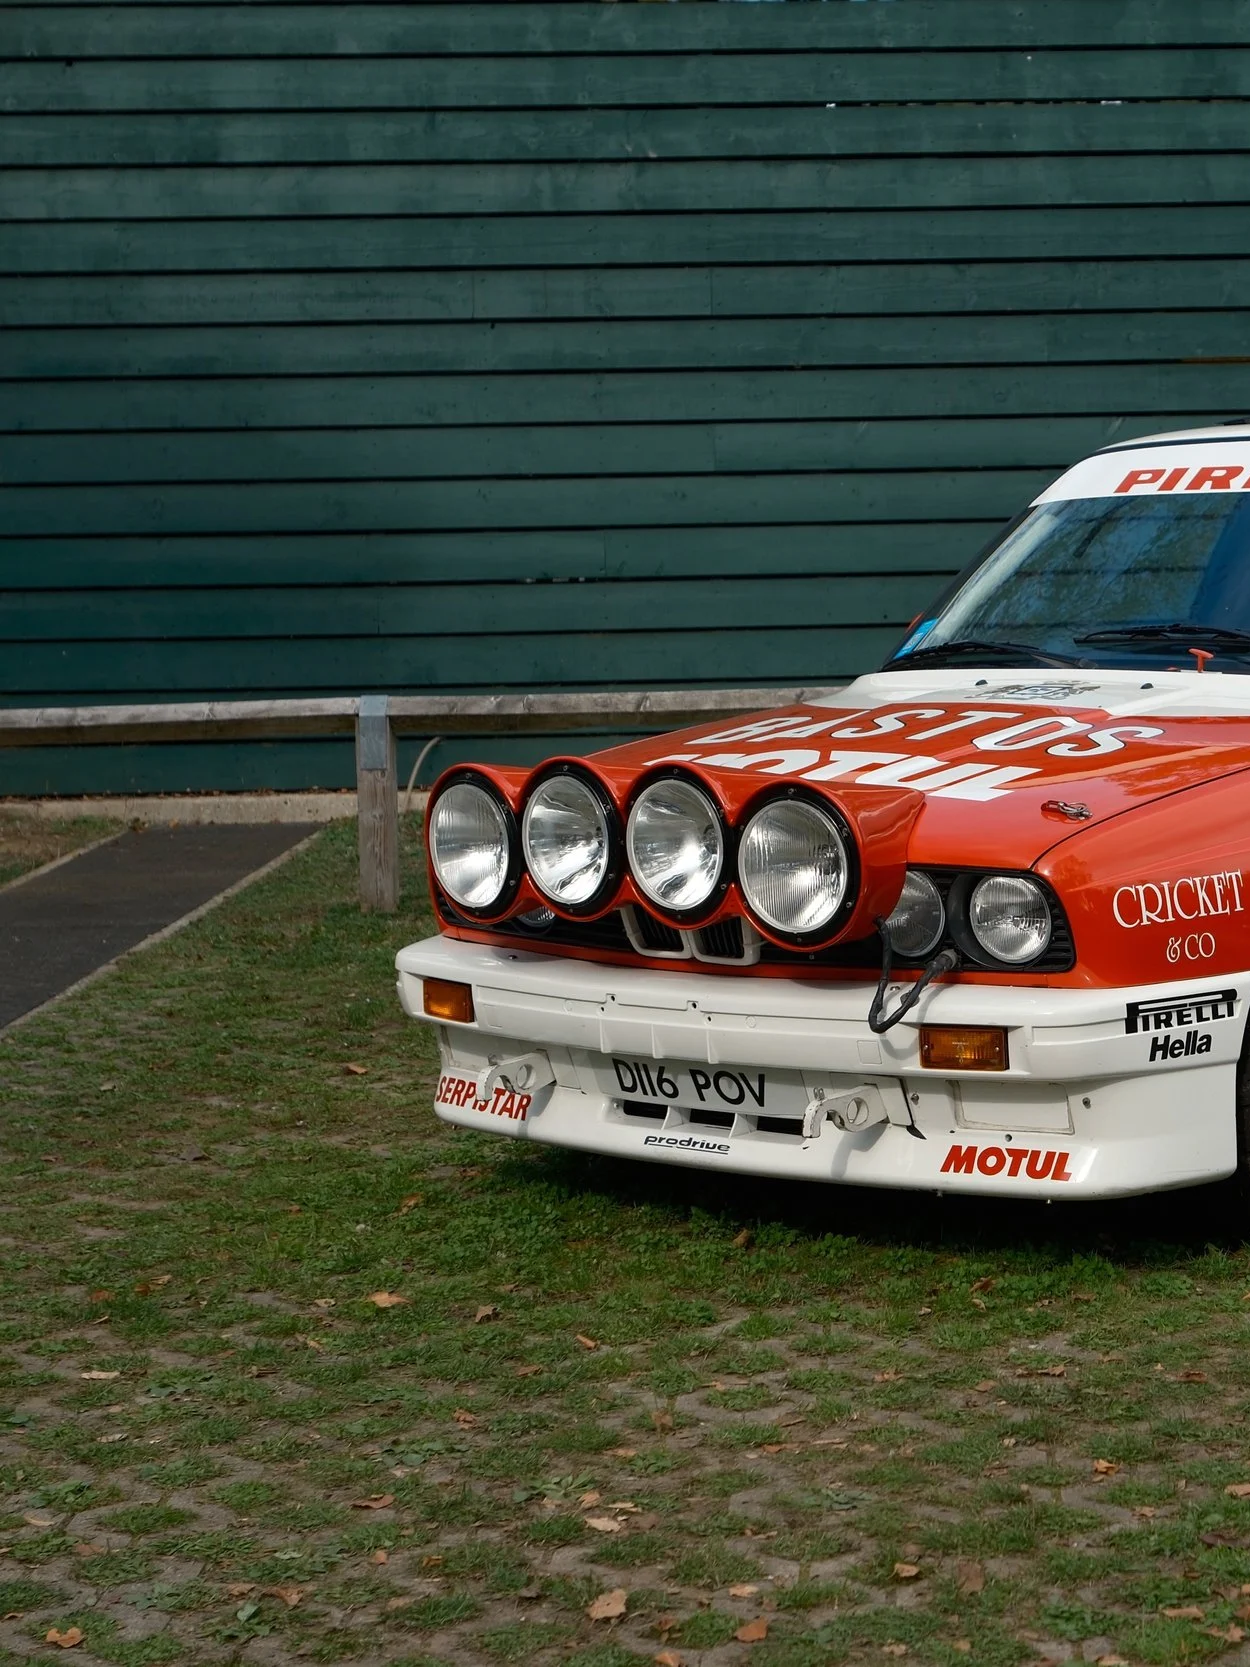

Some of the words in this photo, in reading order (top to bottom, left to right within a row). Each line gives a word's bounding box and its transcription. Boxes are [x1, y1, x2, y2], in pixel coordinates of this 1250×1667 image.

[684, 709, 1165, 757] BASTOS
[1113, 869, 1244, 928] CRICKET
[1125, 989, 1237, 1034] PIRELLI
[1149, 1030, 1212, 1062] Hella
[689, 1068, 765, 1107] POV
[644, 1135, 731, 1155] prodrive
[940, 1145, 1072, 1181] MOTUL
